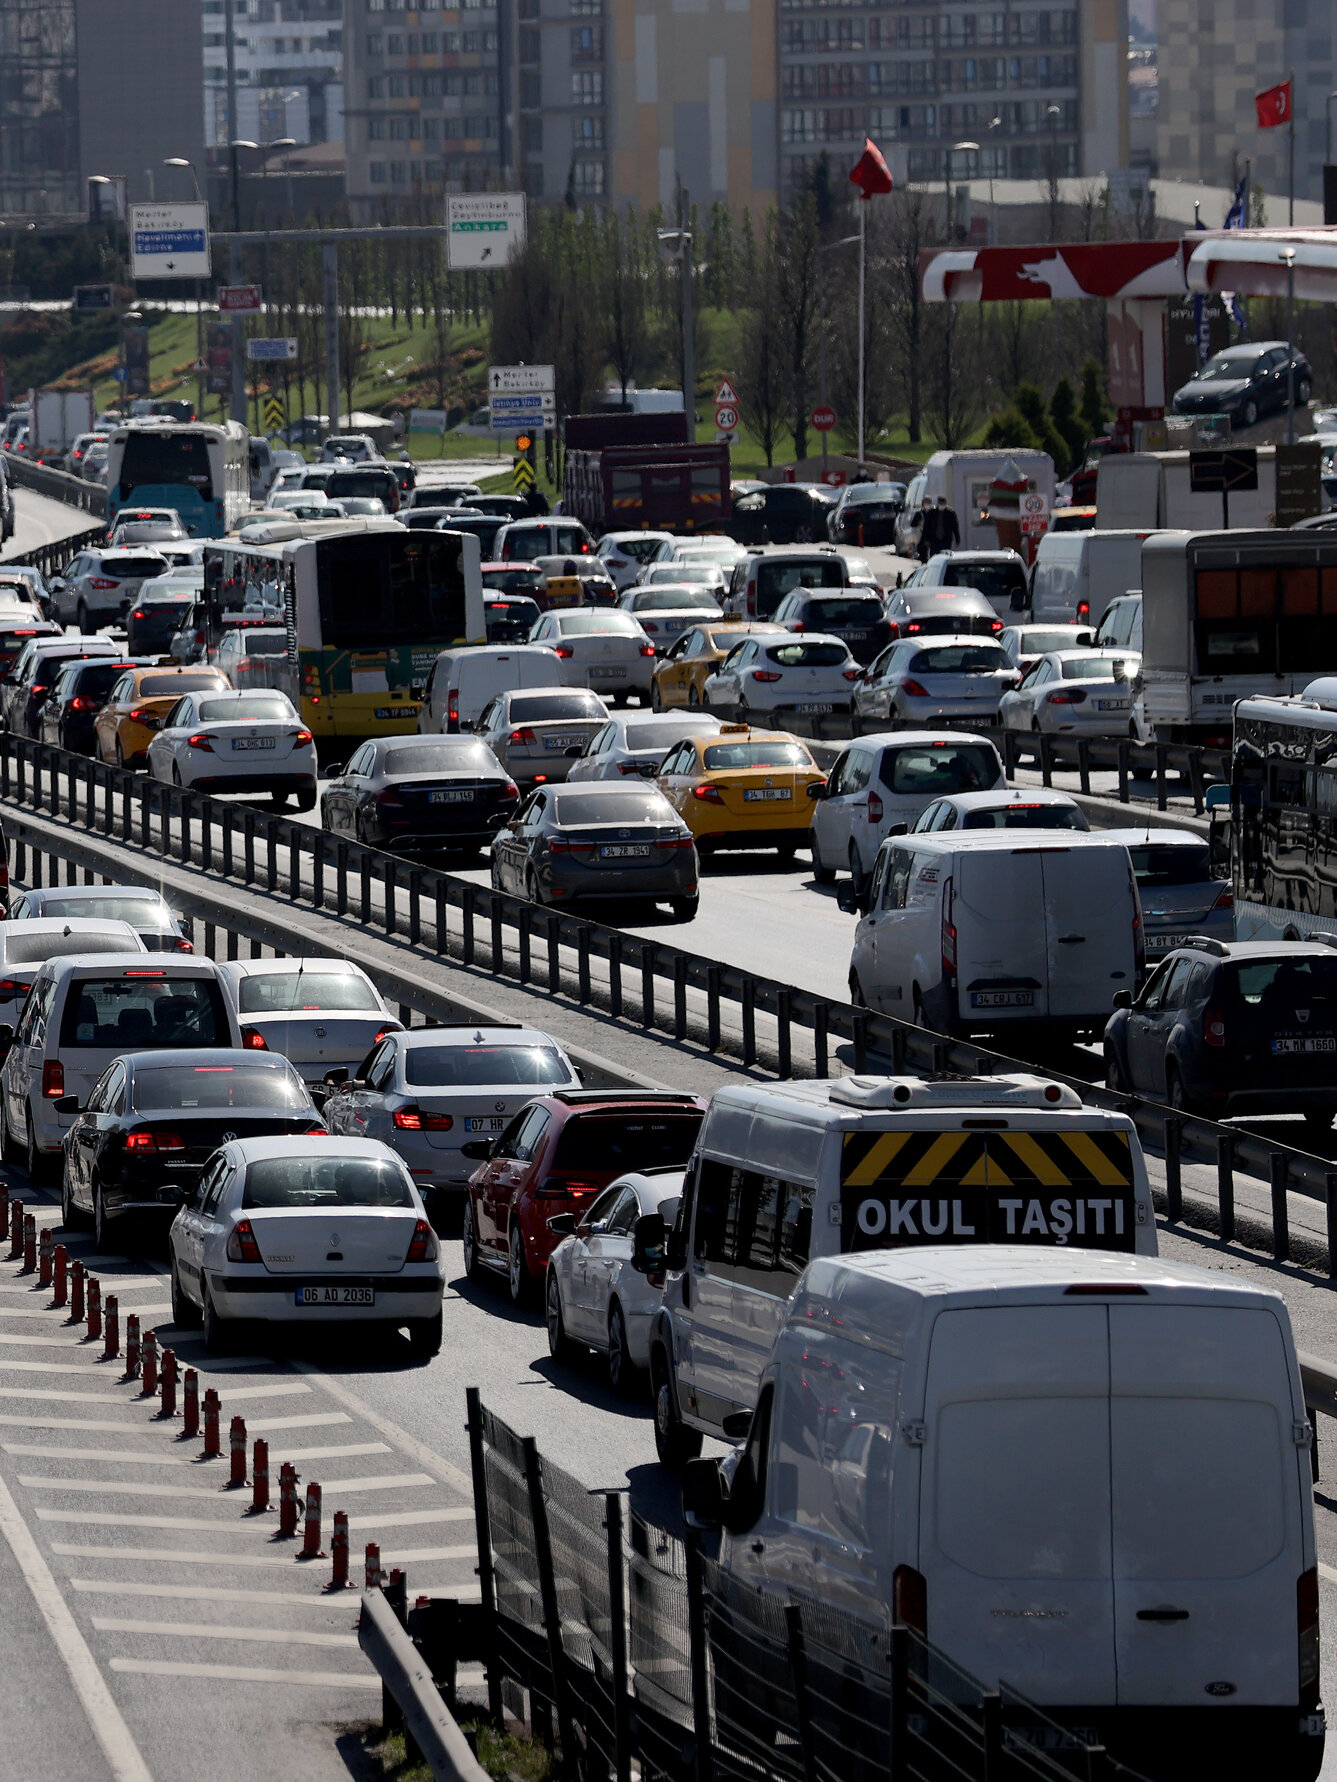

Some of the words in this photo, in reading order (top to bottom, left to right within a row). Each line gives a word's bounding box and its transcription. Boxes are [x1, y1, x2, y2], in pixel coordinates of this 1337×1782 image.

[454, 222, 506, 231] Ankara
[720, 412, 735, 423] 20
[814, 414, 834, 423] DUR
[750, 790, 758, 798] 34
[606, 847, 615, 856] 34
[619, 847, 628, 855] ZR
[978, 995, 990, 1004] 34
[1277, 1039, 1290, 1051] 34
[1311, 1038, 1335, 1050] 1660
[471, 1118, 484, 1130] 07
[490, 1118, 504, 1130] HR
[856, 1198, 976, 1236] OKUL
[997, 1198, 1125, 1245] TAŞITI
[304, 1288, 318, 1302] 06
[324, 1288, 339, 1301] AD
[343, 1288, 372, 1301] 2036
